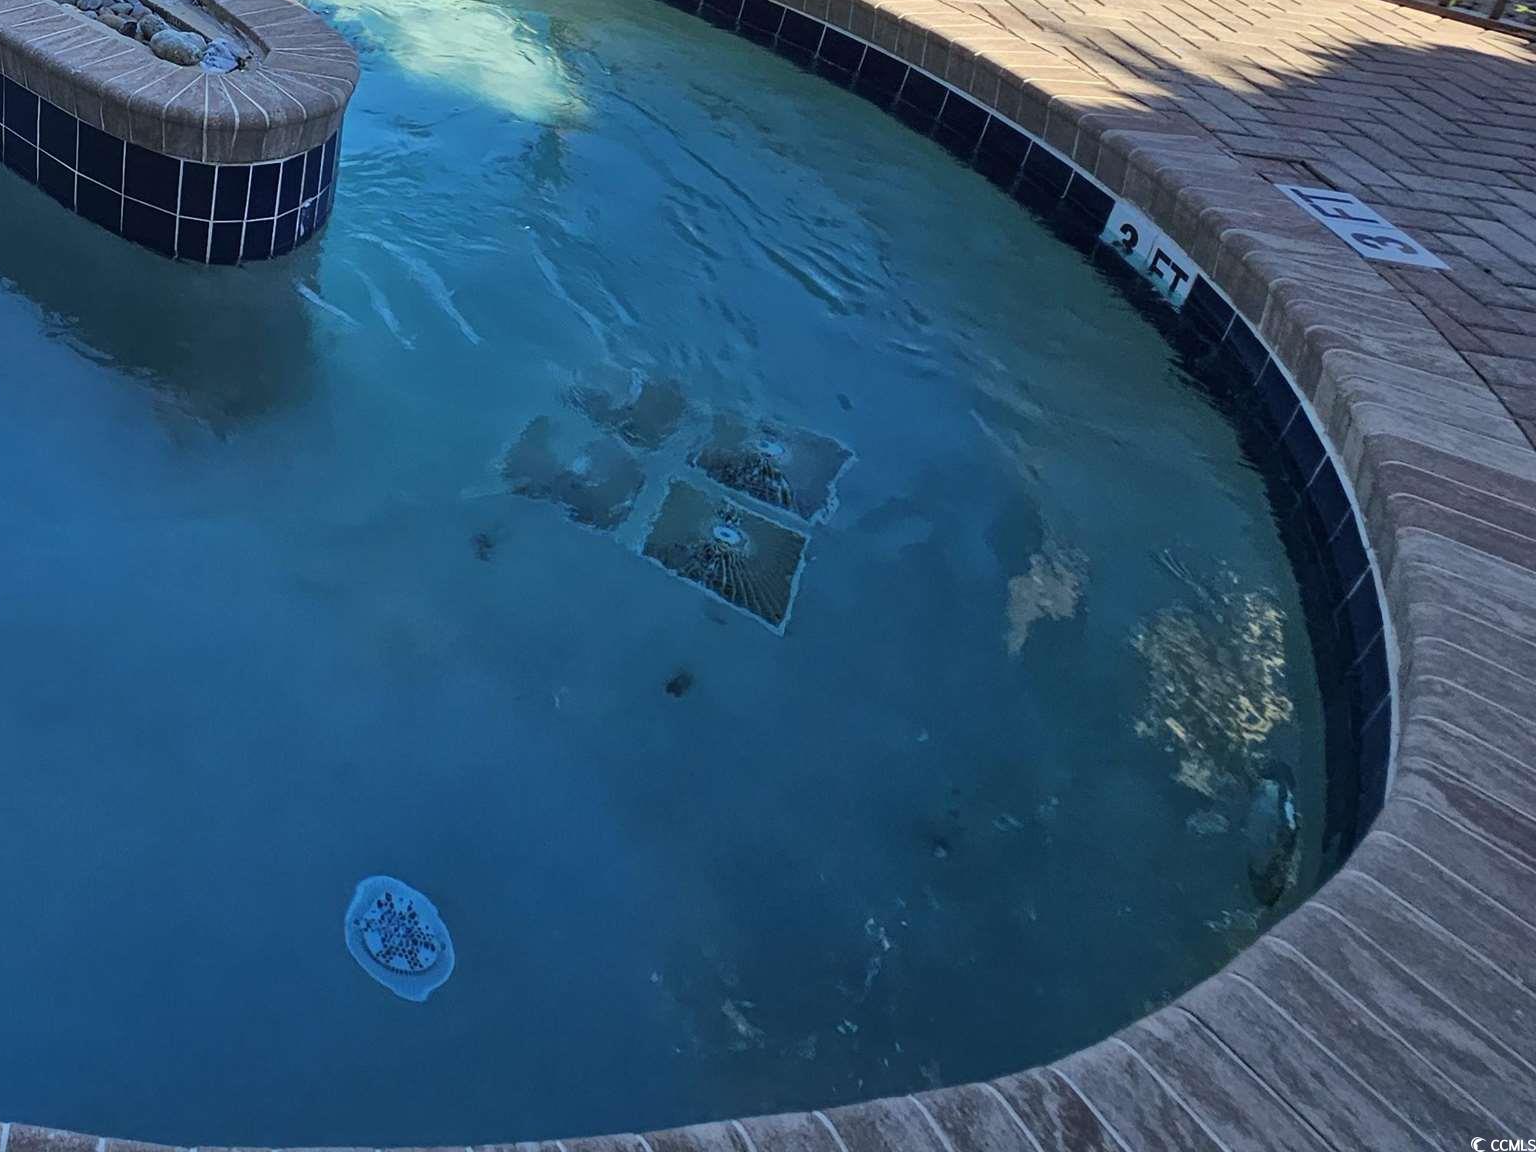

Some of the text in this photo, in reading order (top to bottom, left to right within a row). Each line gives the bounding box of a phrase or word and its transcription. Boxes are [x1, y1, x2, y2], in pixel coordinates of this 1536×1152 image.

[1290, 188, 1418, 254] 3 FT
[1112, 223, 1189, 295] 3 FT
